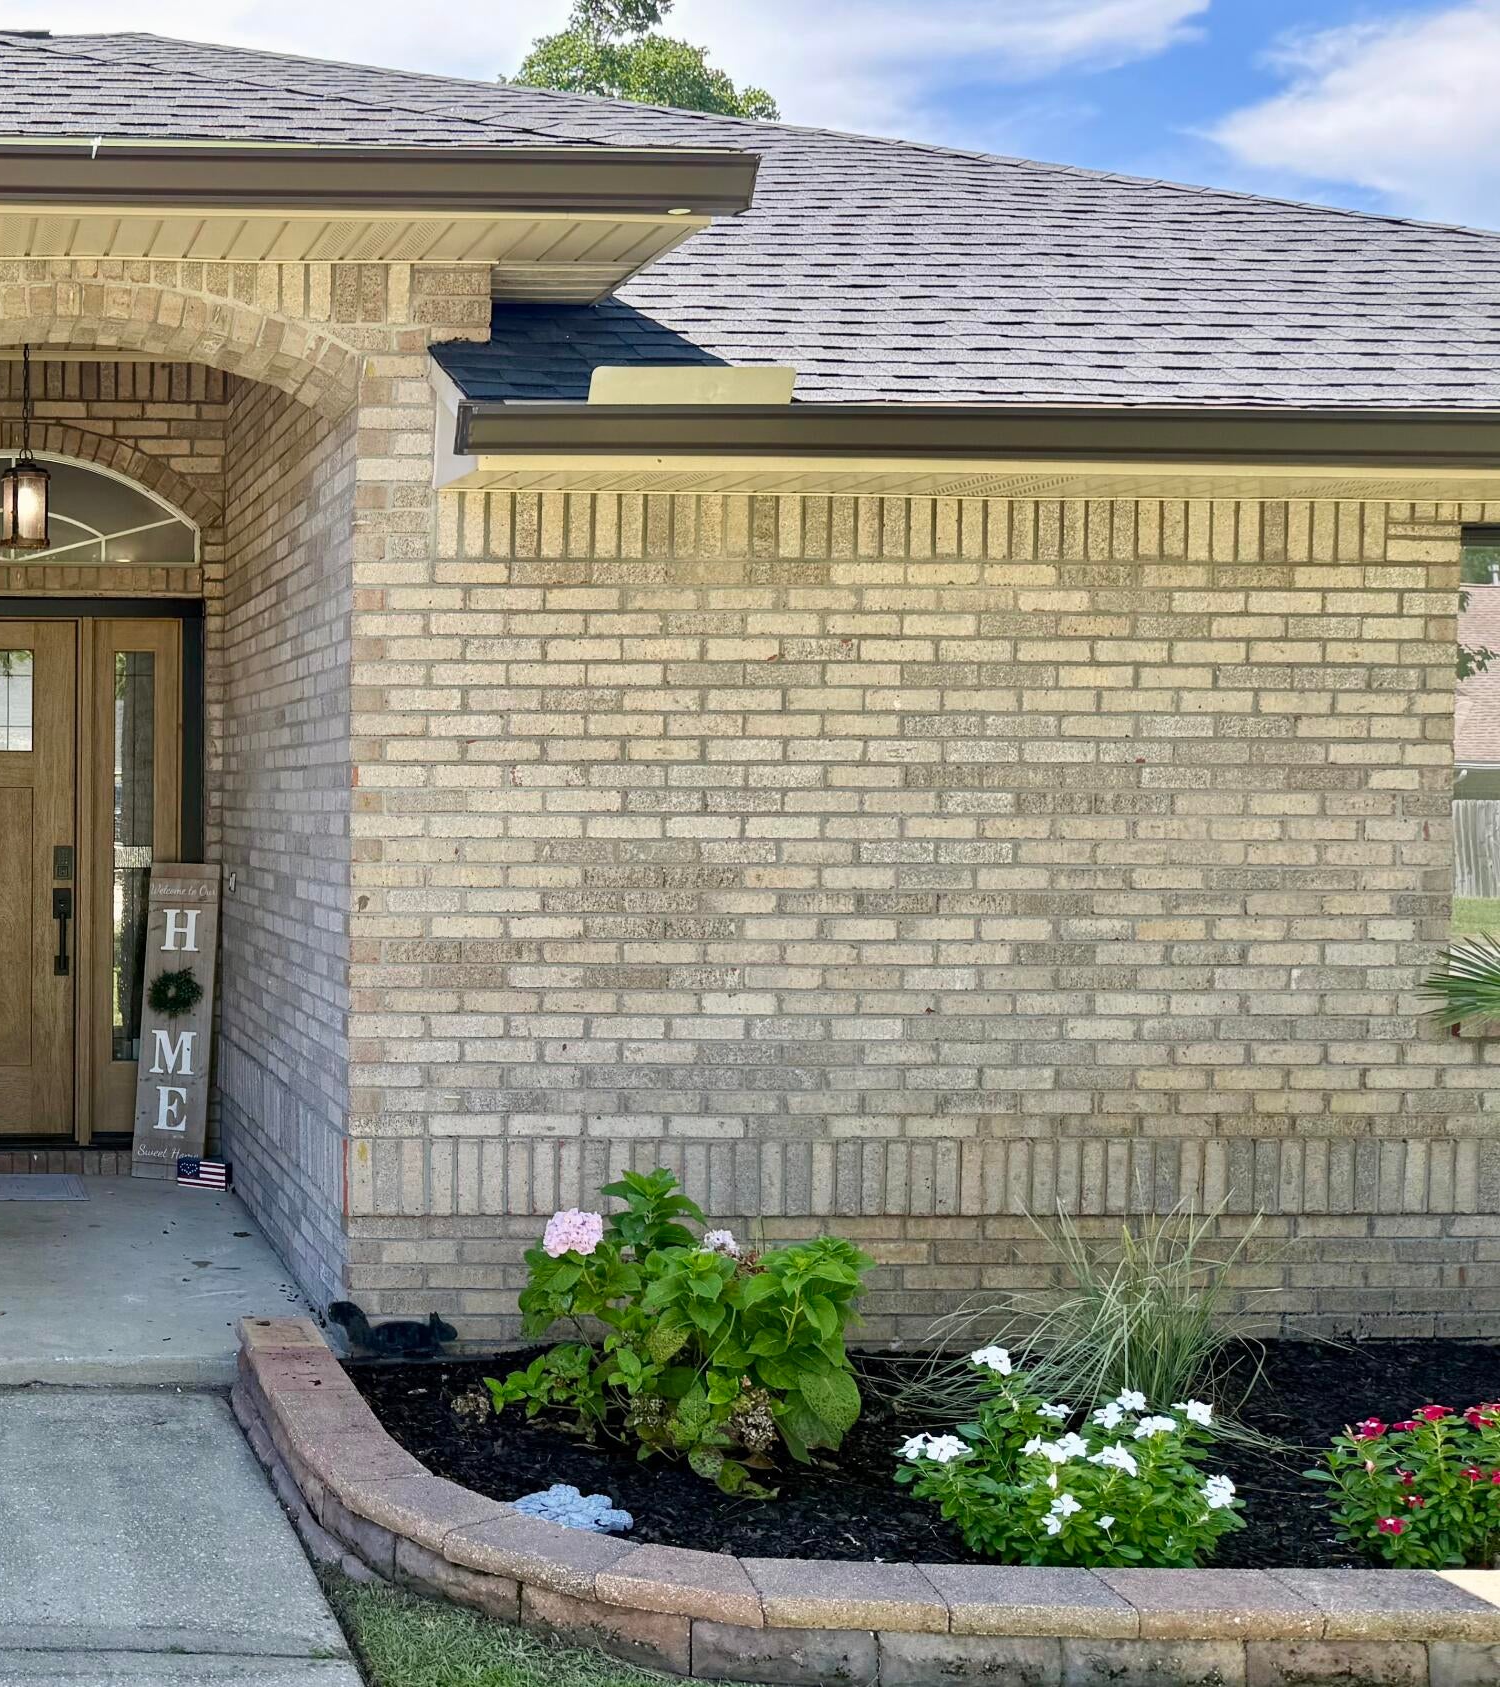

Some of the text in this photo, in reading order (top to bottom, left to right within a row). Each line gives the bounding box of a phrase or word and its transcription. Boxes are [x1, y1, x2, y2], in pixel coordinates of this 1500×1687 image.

[149, 882, 217, 897] Welcome to Our
[137, 1143, 168, 1159] Sweet
